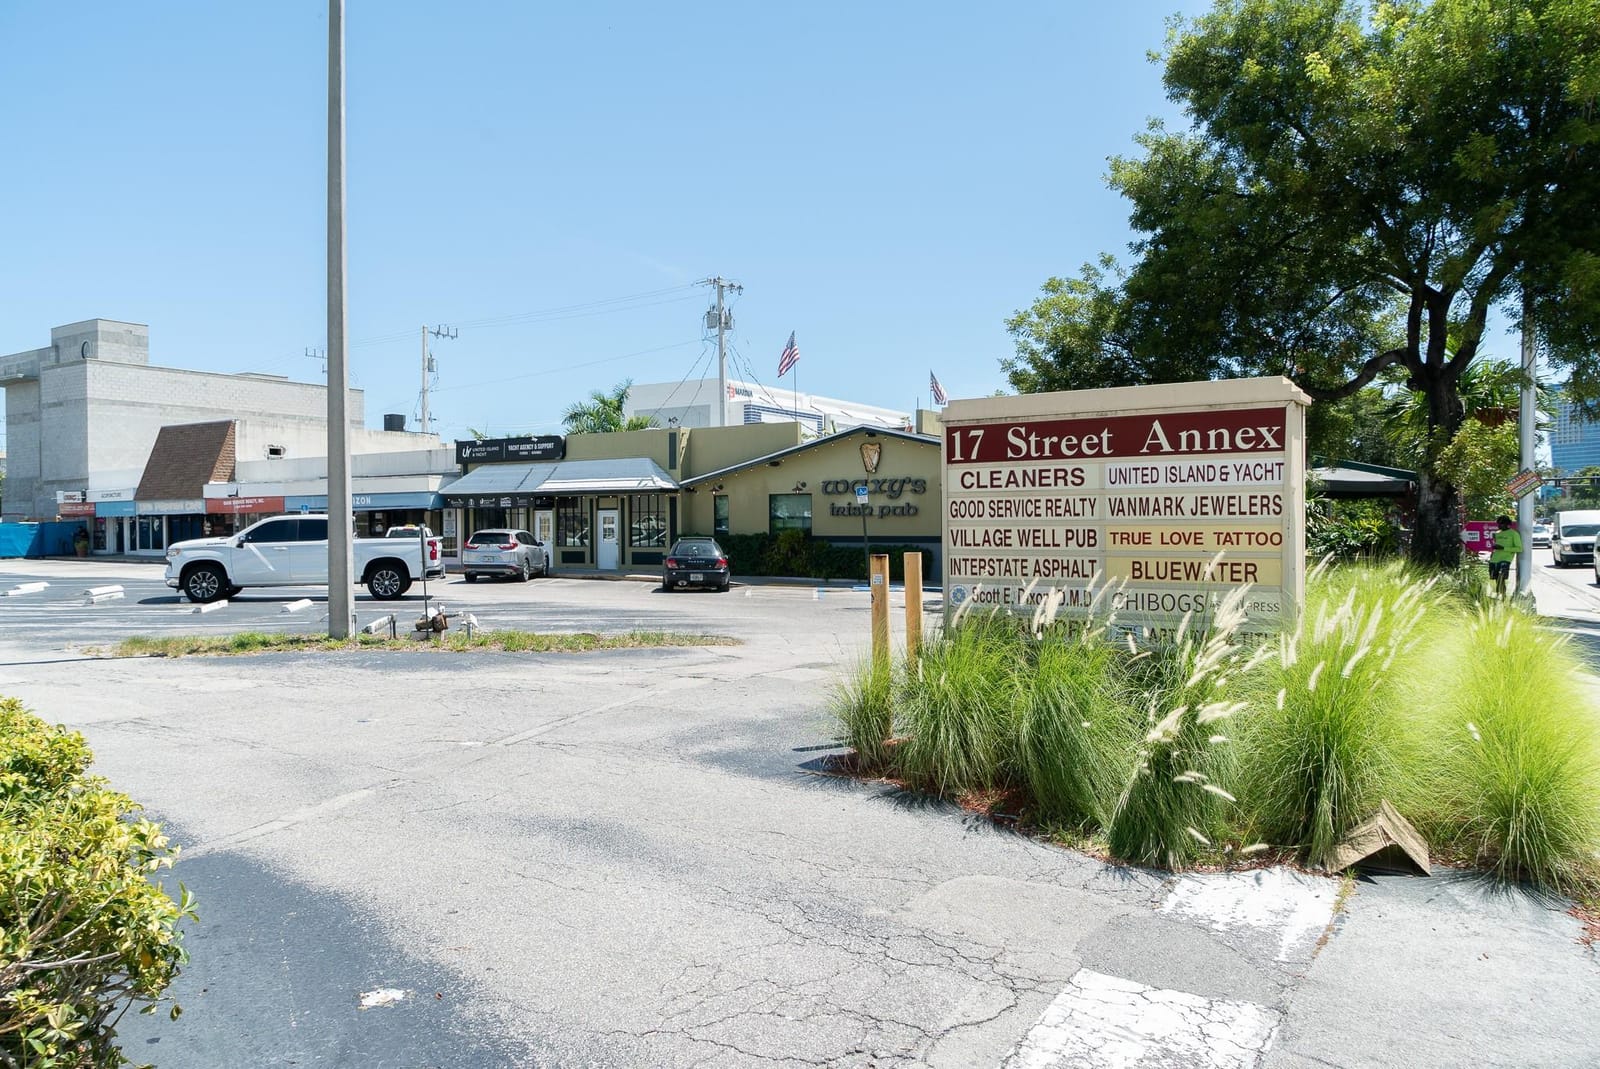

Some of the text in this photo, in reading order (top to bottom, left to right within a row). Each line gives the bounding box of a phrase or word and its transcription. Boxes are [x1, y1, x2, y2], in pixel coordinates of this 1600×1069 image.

[951, 419, 1282, 461] 17 Street Annex
[960, 467, 1085, 490] CLEANERS
[1109, 462, 1285, 485] UNITED ISLAND & YACHT
[878, 502, 918, 519] pub
[950, 497, 1096, 519] GOOD SERVICE REALTY
[1108, 494, 1283, 517] VANMARK JEWELERS
[950, 529, 1097, 548] VILLAGE WELL PUB
[1110, 531, 1283, 546] TRUE LOVE TATTOO
[950, 558, 1097, 578] INTERSTATE ASPHALT
[1131, 560, 1258, 583] BLUEWATER
[972, 586, 1000, 604] Scott
[1003, 587, 1014, 605] E.
